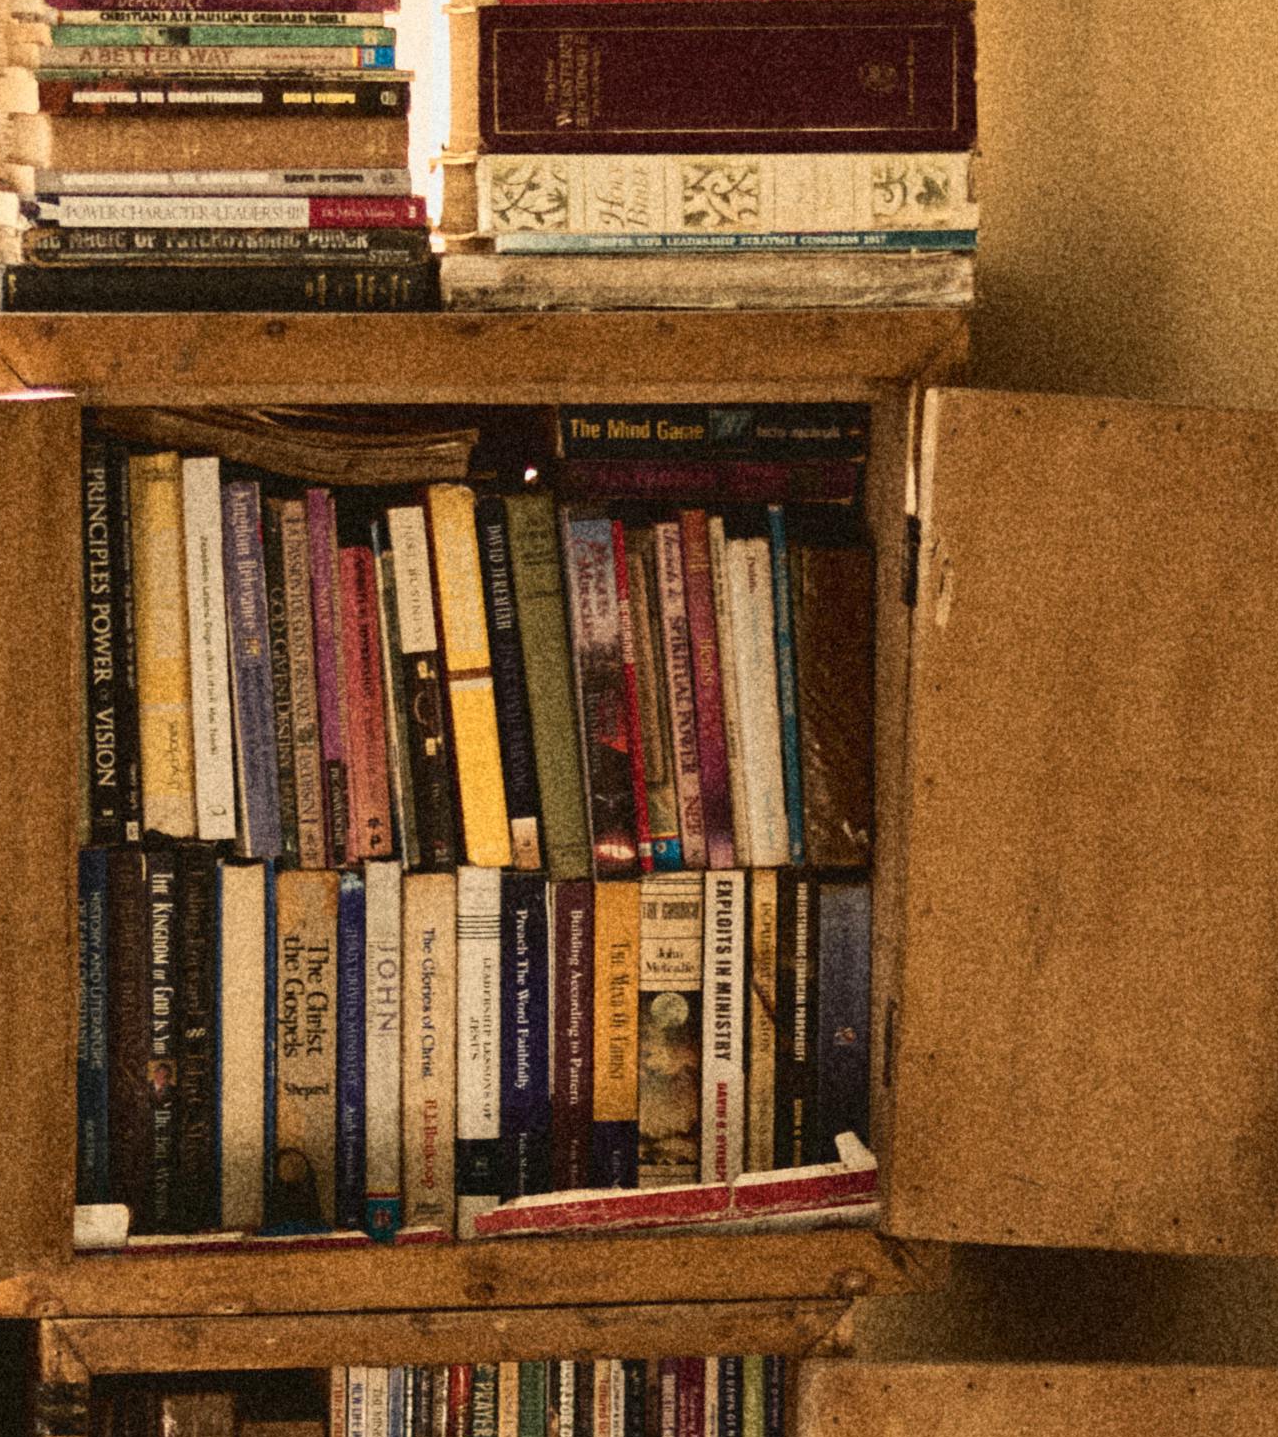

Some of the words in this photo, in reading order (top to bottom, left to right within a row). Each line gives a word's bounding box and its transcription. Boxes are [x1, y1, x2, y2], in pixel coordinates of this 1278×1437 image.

[100, 12, 167, 24] CHRISTIANS
[194, 12, 248, 24] MUSLIMS
[79, 47, 93, 64] A
[94, 47, 182, 64] BETTER
[187, 47, 235, 64] WAY
[570, 419, 601, 438] The
[607, 419, 651, 439] Mind
[657, 420, 705, 440] Game
[87, 467, 110, 595] PRINCIPLES
[488, 524, 506, 562] DAVID
[491, 566, 512, 630] JEREMIAH
[92, 603, 115, 684] POWER
[95, 706, 118, 787] VISION
[677, 712, 700, 775] POWER
[89, 891, 103, 948] HISTORY
[152, 902, 174, 964] KINGDOM
[421, 927, 436, 954] The
[516, 909, 529, 955] Preach
[568, 909, 584, 965] Building
[714, 880, 733, 955] EXPLOITS
[90, 952, 104, 982] AND
[283, 936, 304, 974] the
[306, 938, 330, 982] The
[517, 958, 529, 985] The
[715, 959, 732, 976] IN
[152, 986, 175, 1016] GOD
[377, 946, 398, 1031] JOHN
[421, 958, 437, 1012] Glories
[483, 957, 492, 1036] LEADERSHIP
[516, 988, 530, 1024] Word
[567, 970, 584, 1038] According
[278, 977, 305, 1058] Gospels
[306, 991, 330, 1056] Christ
[421, 1016, 437, 1031] of
[469, 1016, 480, 1061] JESUS
[714, 981, 732, 1061] MINISTRY
[421, 1034, 437, 1077] Christ
[483, 1041, 492, 1100] LESSONS
[513, 1028, 530, 1089] Faithfully
[570, 1041, 581, 1054] to
[569, 1057, 583, 1105] Pattern
[483, 1102, 492, 1121] OF
[352, 1383, 363, 1405] NEW
[473, 1381, 495, 1437] PRAYER
[352, 1408, 363, 1428] LIFE
